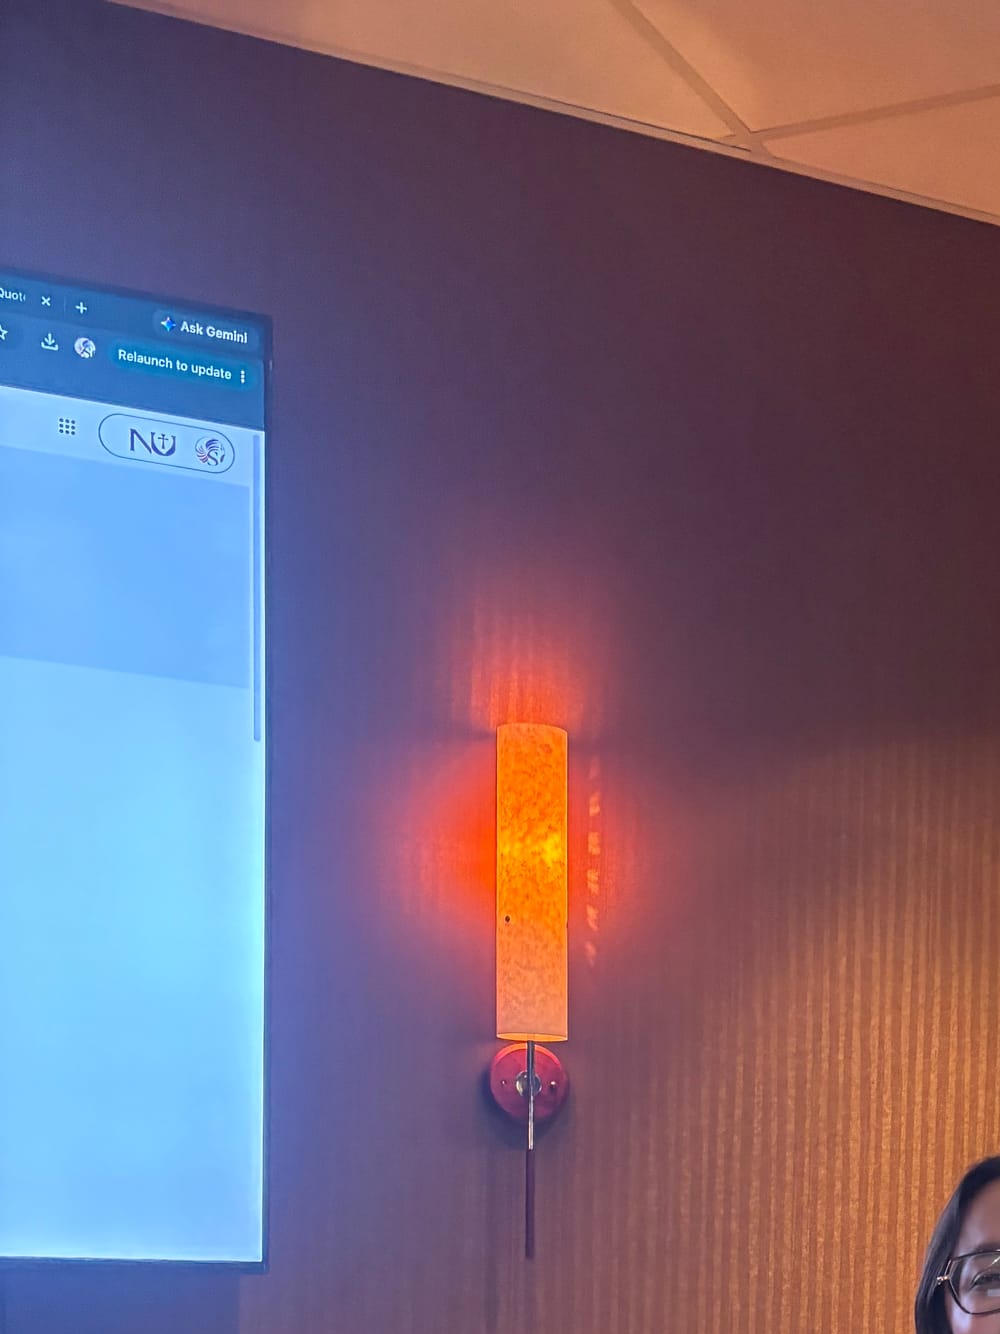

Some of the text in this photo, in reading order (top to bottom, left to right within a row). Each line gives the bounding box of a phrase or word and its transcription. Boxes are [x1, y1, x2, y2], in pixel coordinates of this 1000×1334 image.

[180, 321, 248, 344] Ask Gemini
[118, 349, 232, 380] Relaunch to update
